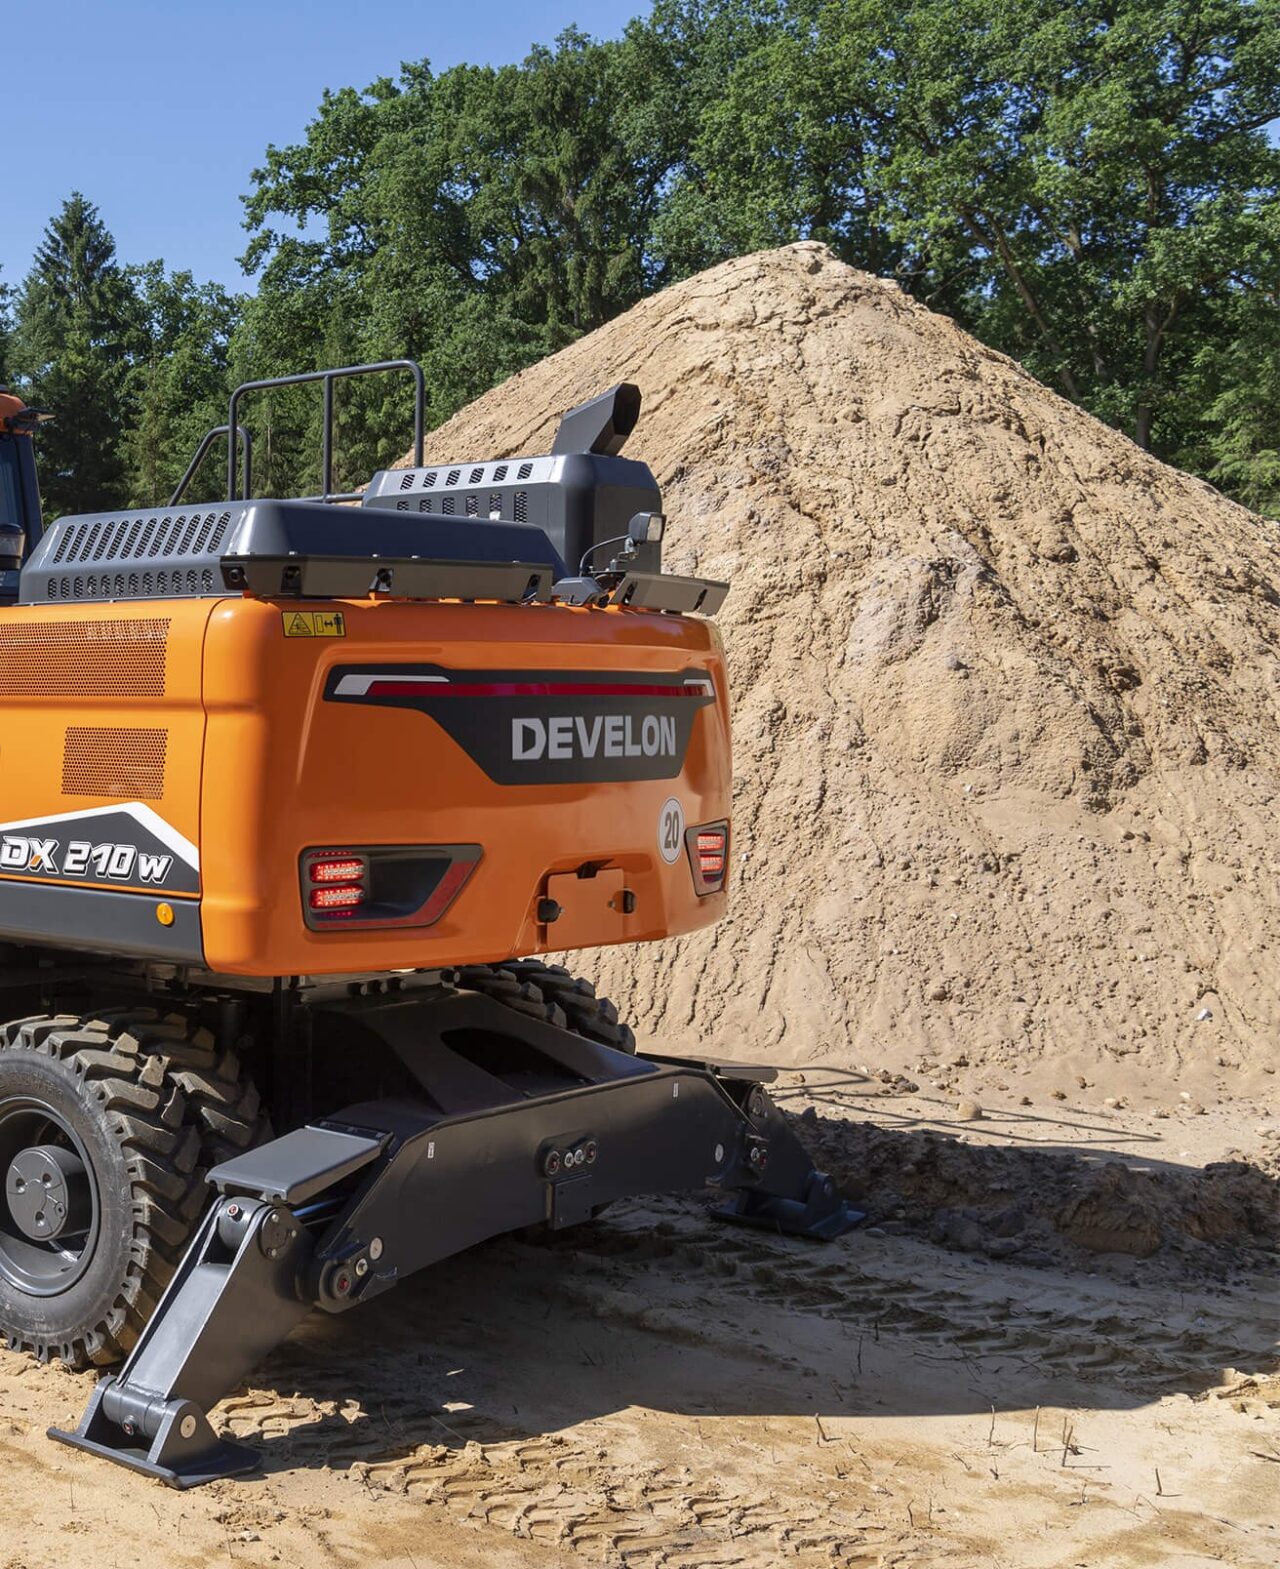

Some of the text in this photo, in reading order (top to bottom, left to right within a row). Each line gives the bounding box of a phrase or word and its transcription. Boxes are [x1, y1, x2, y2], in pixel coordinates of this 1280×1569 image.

[512, 715, 676, 760] DEVELON
[664, 811, 680, 849] 20
[0, 836, 60, 874] DX
